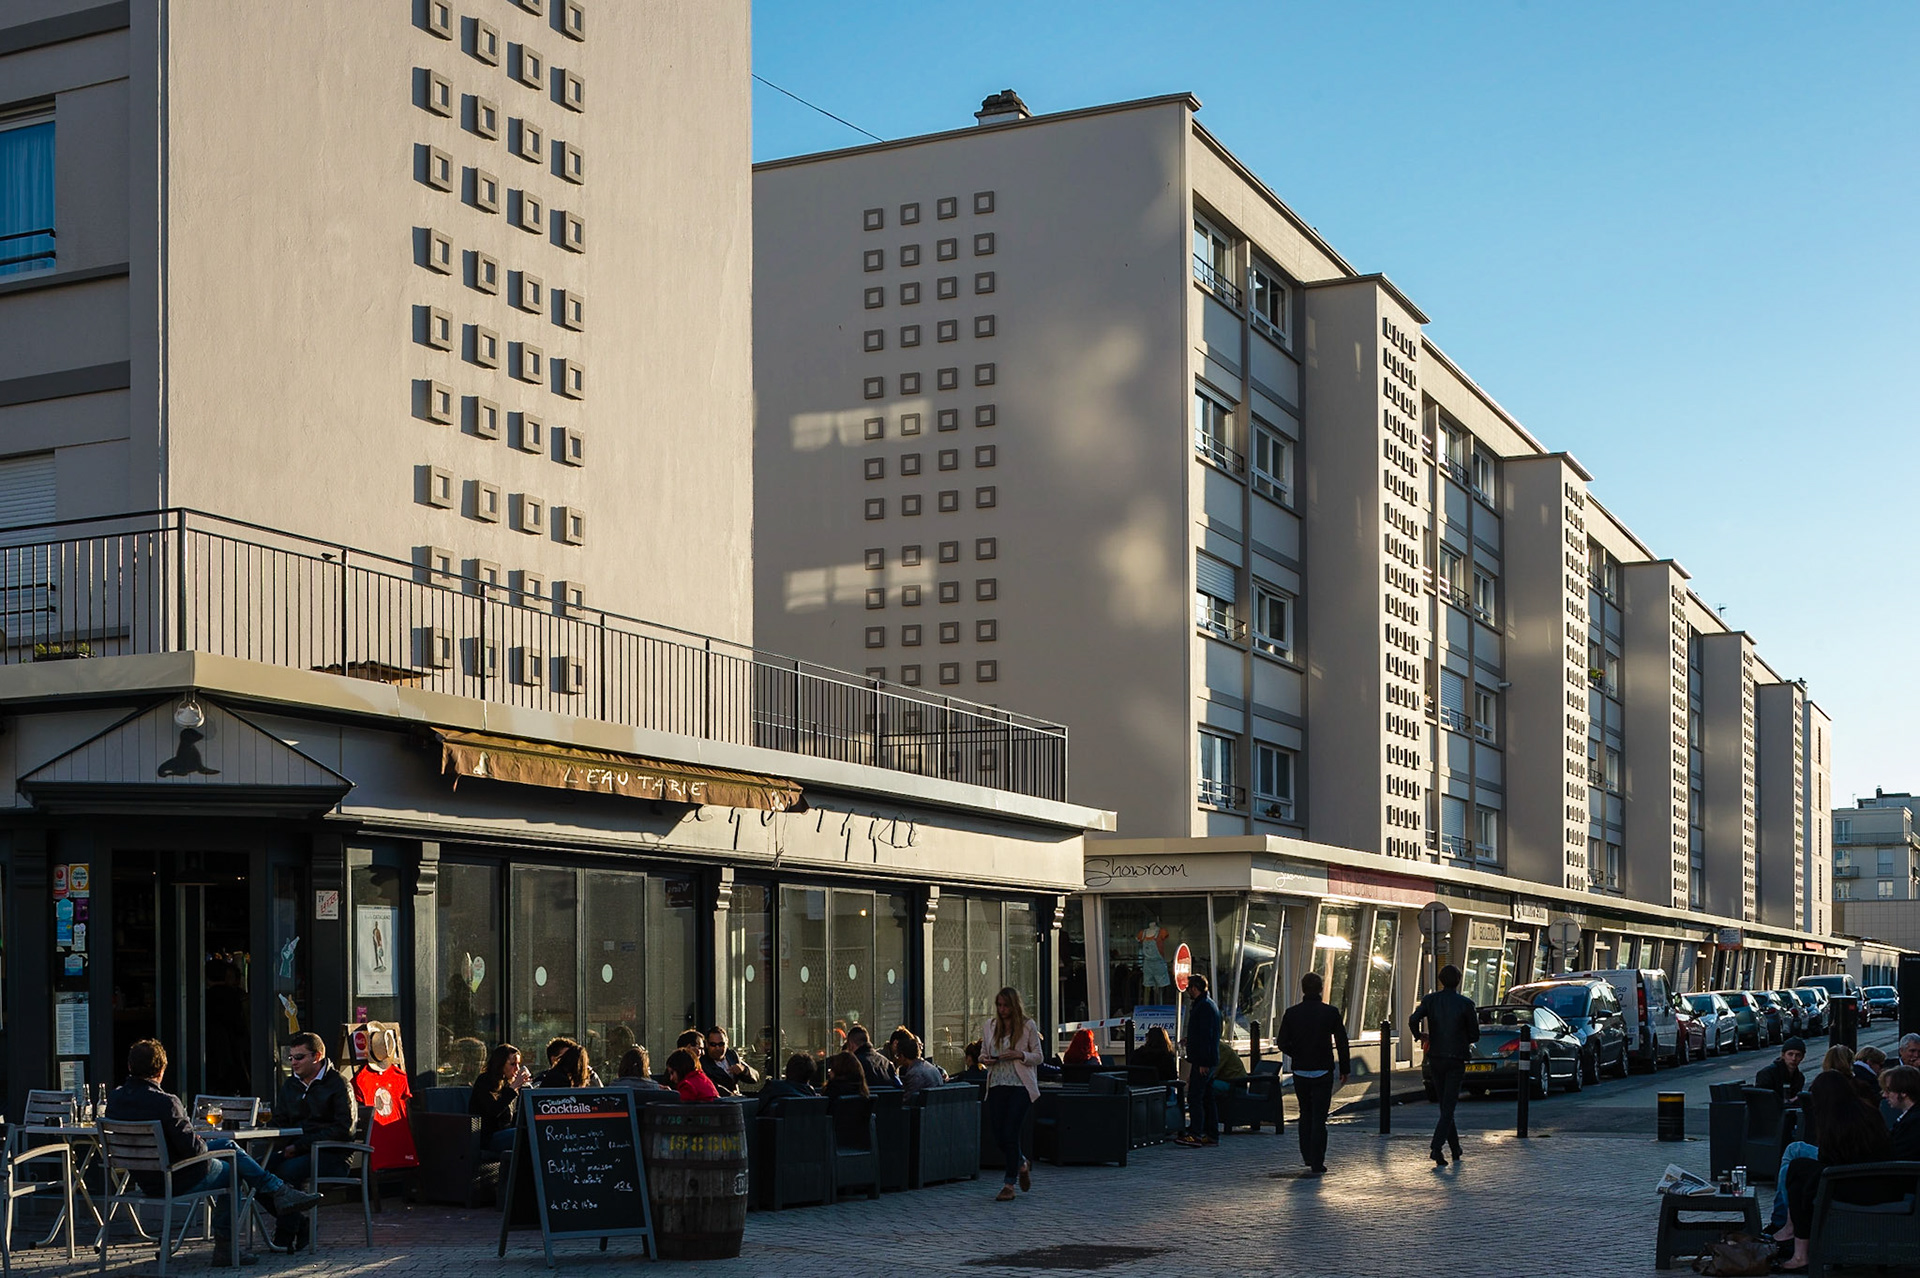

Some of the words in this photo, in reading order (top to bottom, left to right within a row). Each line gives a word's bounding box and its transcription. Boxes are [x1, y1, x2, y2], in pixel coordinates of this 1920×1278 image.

[564, 767, 629, 791] L'EAU
[638, 776, 707, 797] TARIE
[1084, 858, 1188, 887] Showroom
[541, 1103, 592, 1115] Cocktails
